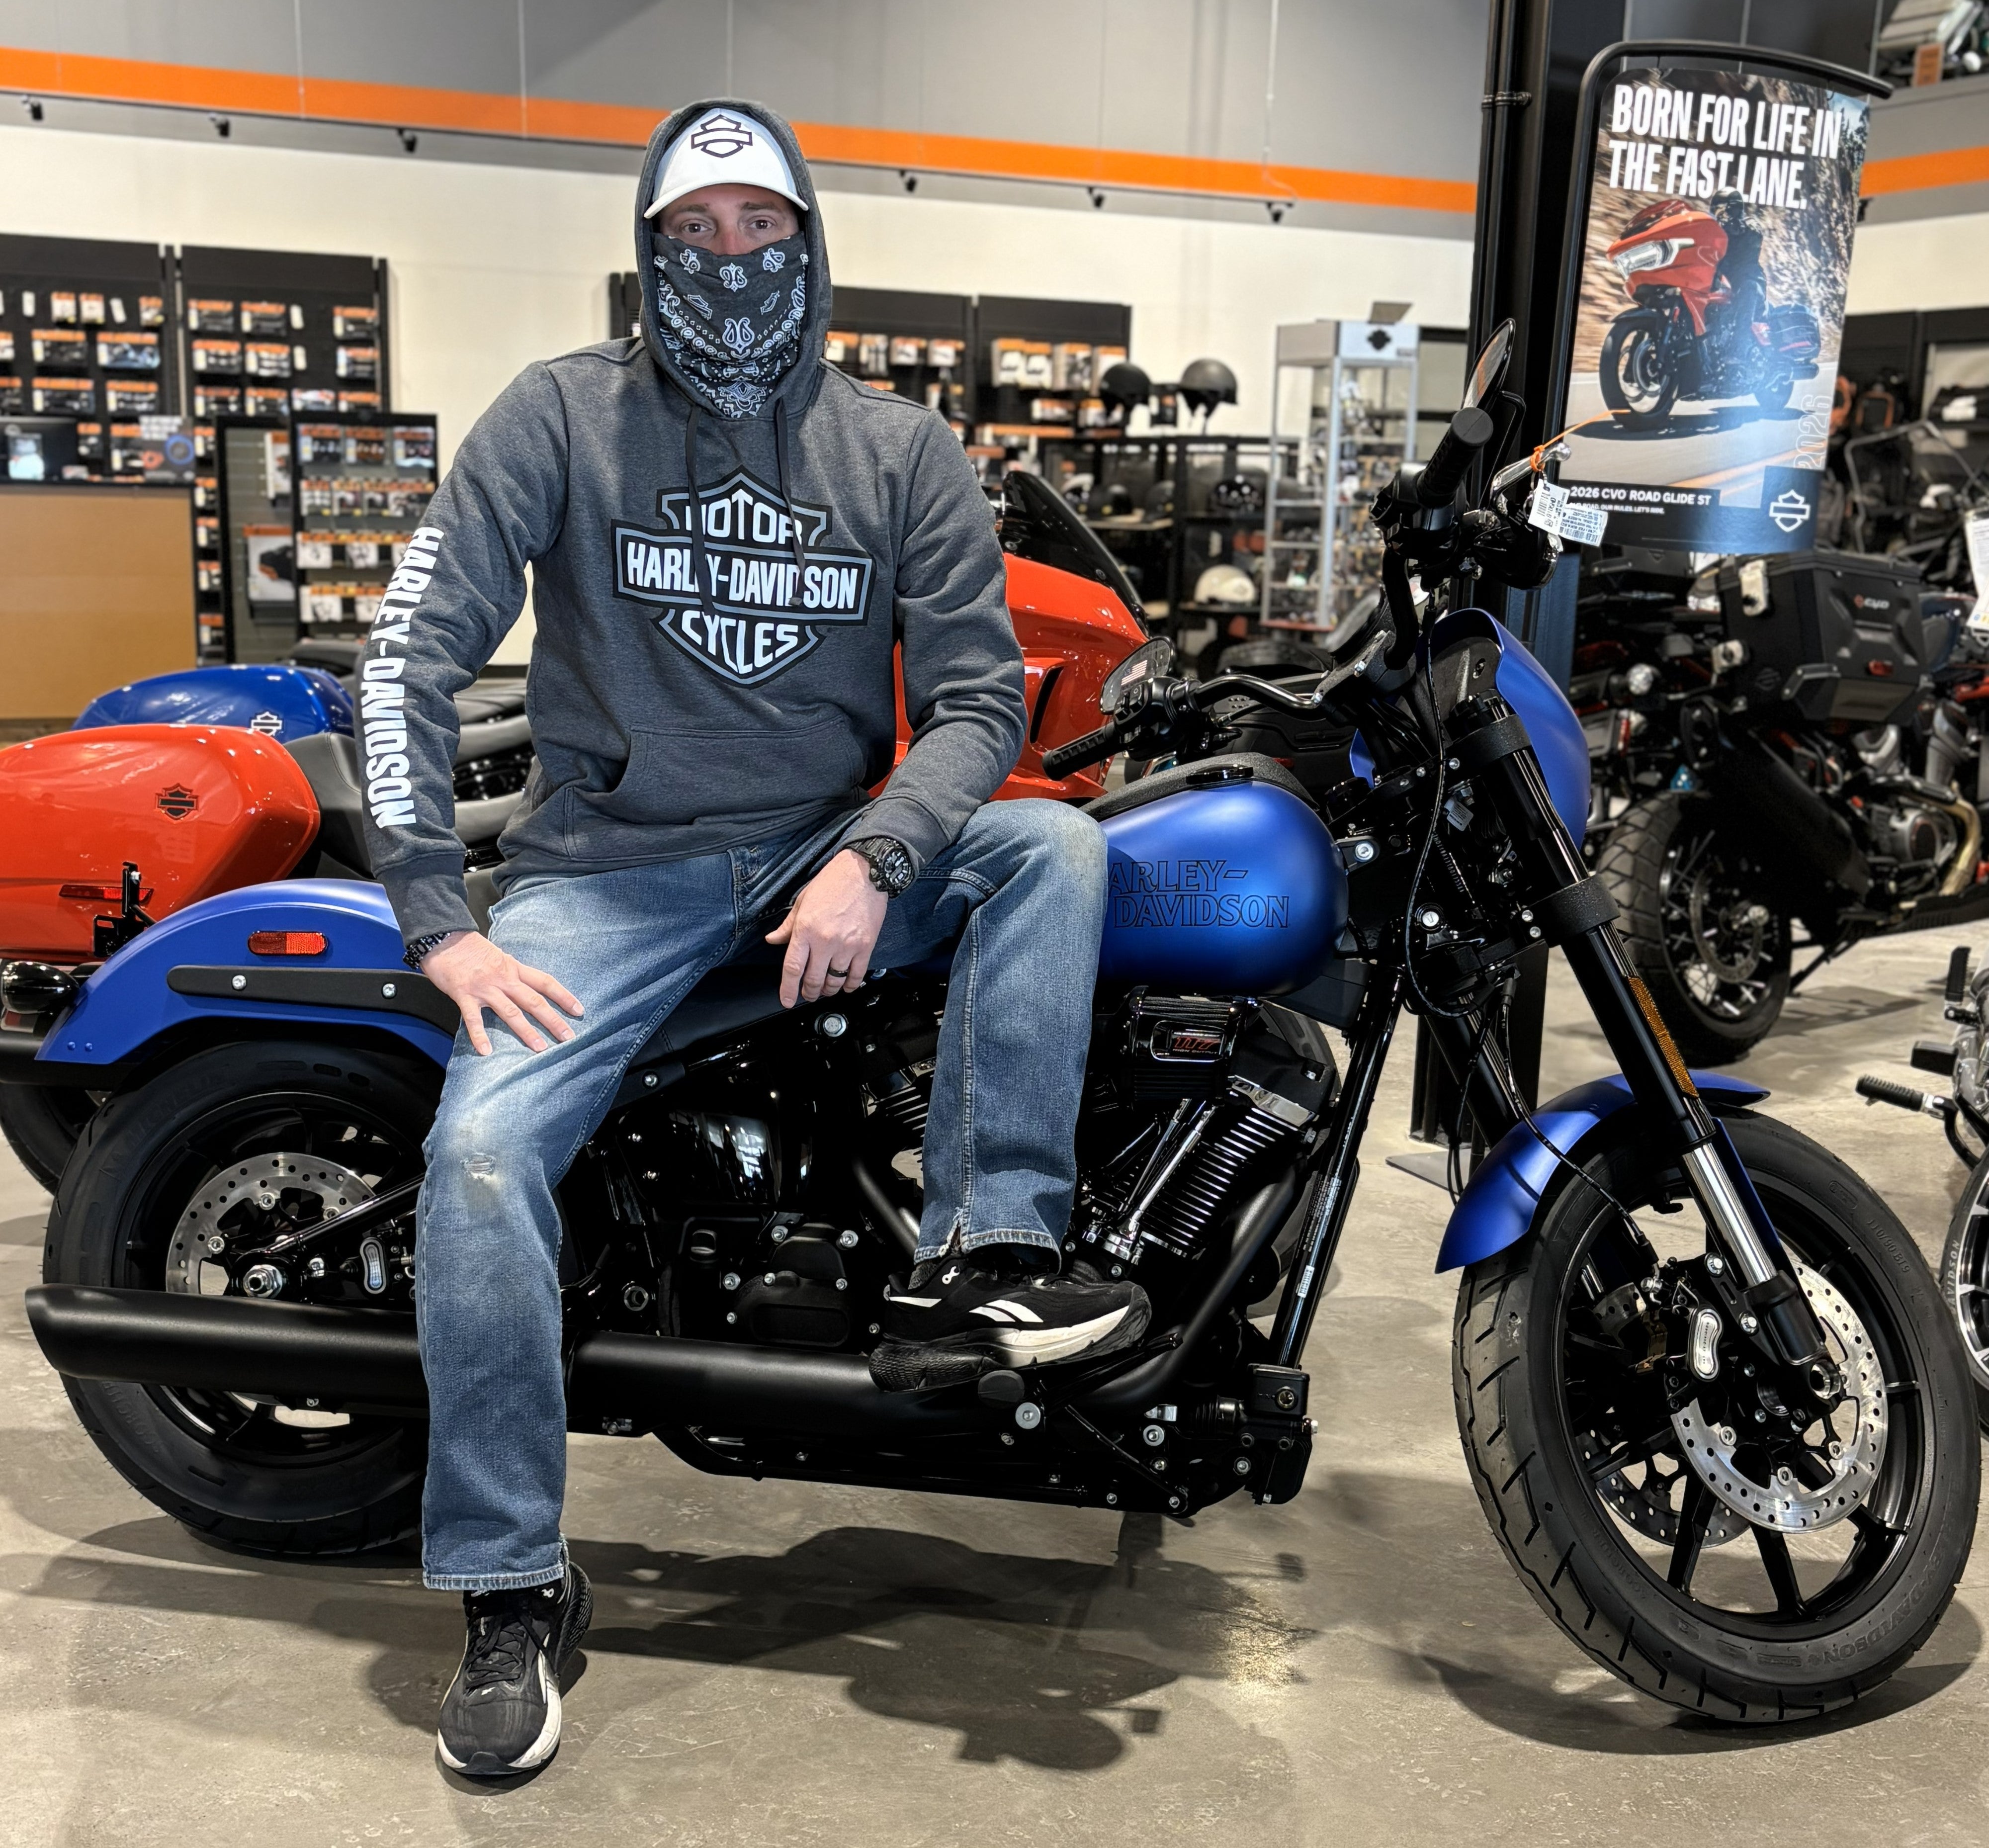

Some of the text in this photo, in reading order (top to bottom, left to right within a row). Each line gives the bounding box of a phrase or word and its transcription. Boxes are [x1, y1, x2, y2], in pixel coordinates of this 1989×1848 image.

[1611, 84, 1841, 159] BORN FOR LIFE IN
[1608, 139, 1809, 210] THE FAST LANE.
[1793, 394, 1832, 469] 2026
[1570, 486, 1712, 506] 2026 CVO ROAD GLIDE ST
[627, 542, 858, 610] HARLY-DAVIDSON
[682, 610, 798, 675] CYCLES
[361, 527, 445, 829] HARLEY-DAVIDSON
[1109, 860, 1248, 895] ARLEY-
[1114, 894, 1289, 928] DAVIDSON
[1946, 1239, 1961, 1309] AVIDSON
